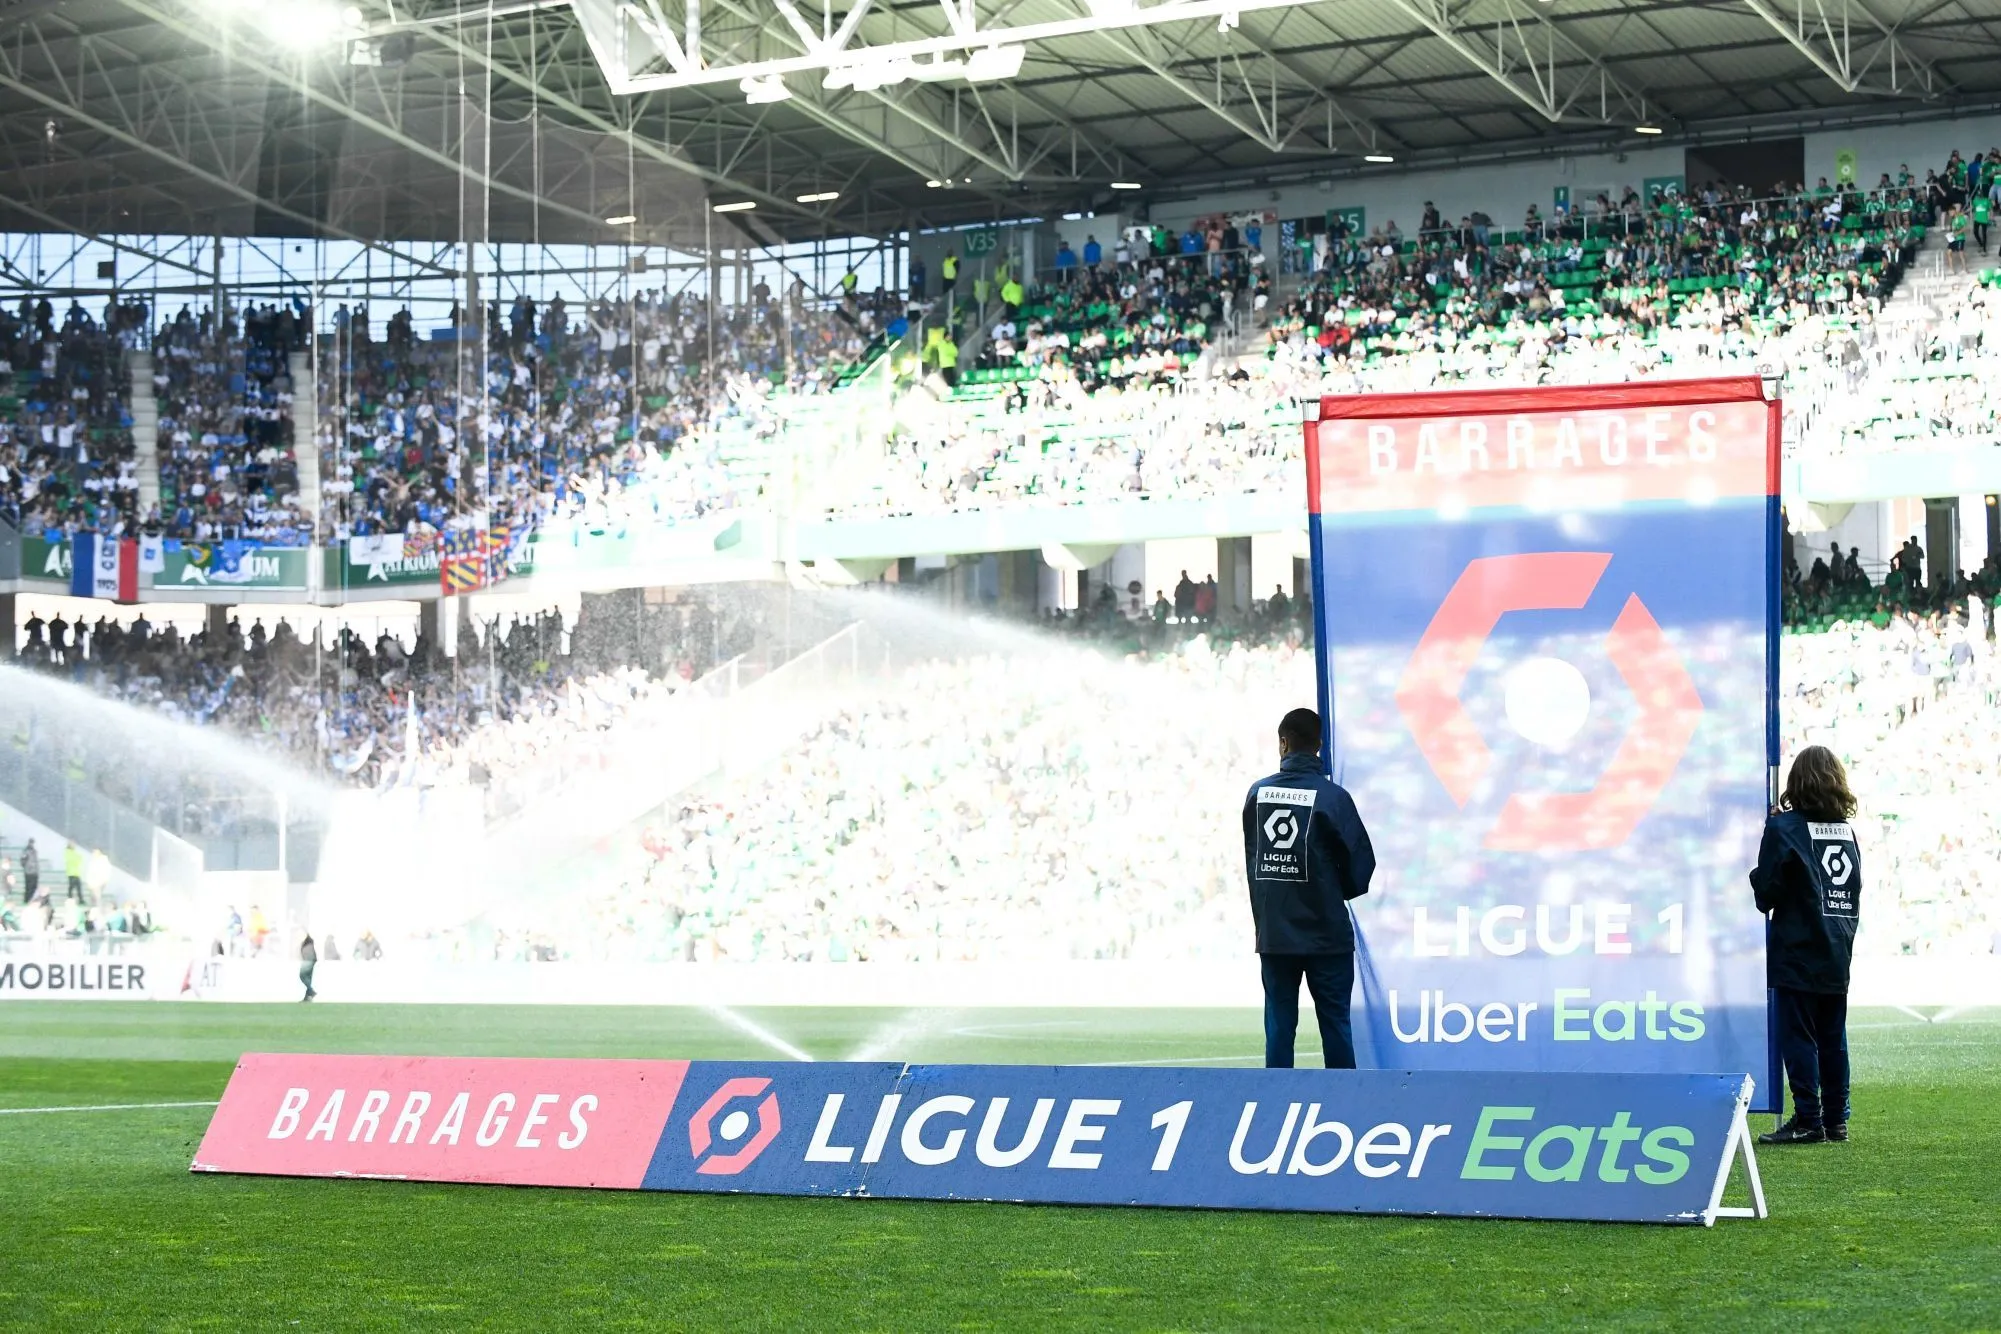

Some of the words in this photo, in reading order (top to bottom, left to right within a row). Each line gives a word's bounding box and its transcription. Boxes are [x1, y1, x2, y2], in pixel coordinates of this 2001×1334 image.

[965, 232, 998, 252] V35
[1367, 410, 1717, 475] BARRAGES
[1264, 791, 1308, 801] BARRAGES
[1260, 863, 1280, 872] Uber
[1280, 865, 1299, 874] Eats
[1263, 852, 1292, 862] LIGUE
[1828, 889, 1846, 898] LGUE
[1413, 903, 1632, 957] LIGUE
[1657, 903, 1684, 954] 1
[1389, 989, 1538, 1043] Uber
[1553, 988, 1706, 1042] Eats
[267, 1087, 598, 1150] BARRAGES
[804, 1093, 1122, 1169] LIGUE
[1150, 1100, 1194, 1171] 1
[1228, 1101, 1452, 1178] Uber
[1459, 1105, 1695, 1185] Eats
